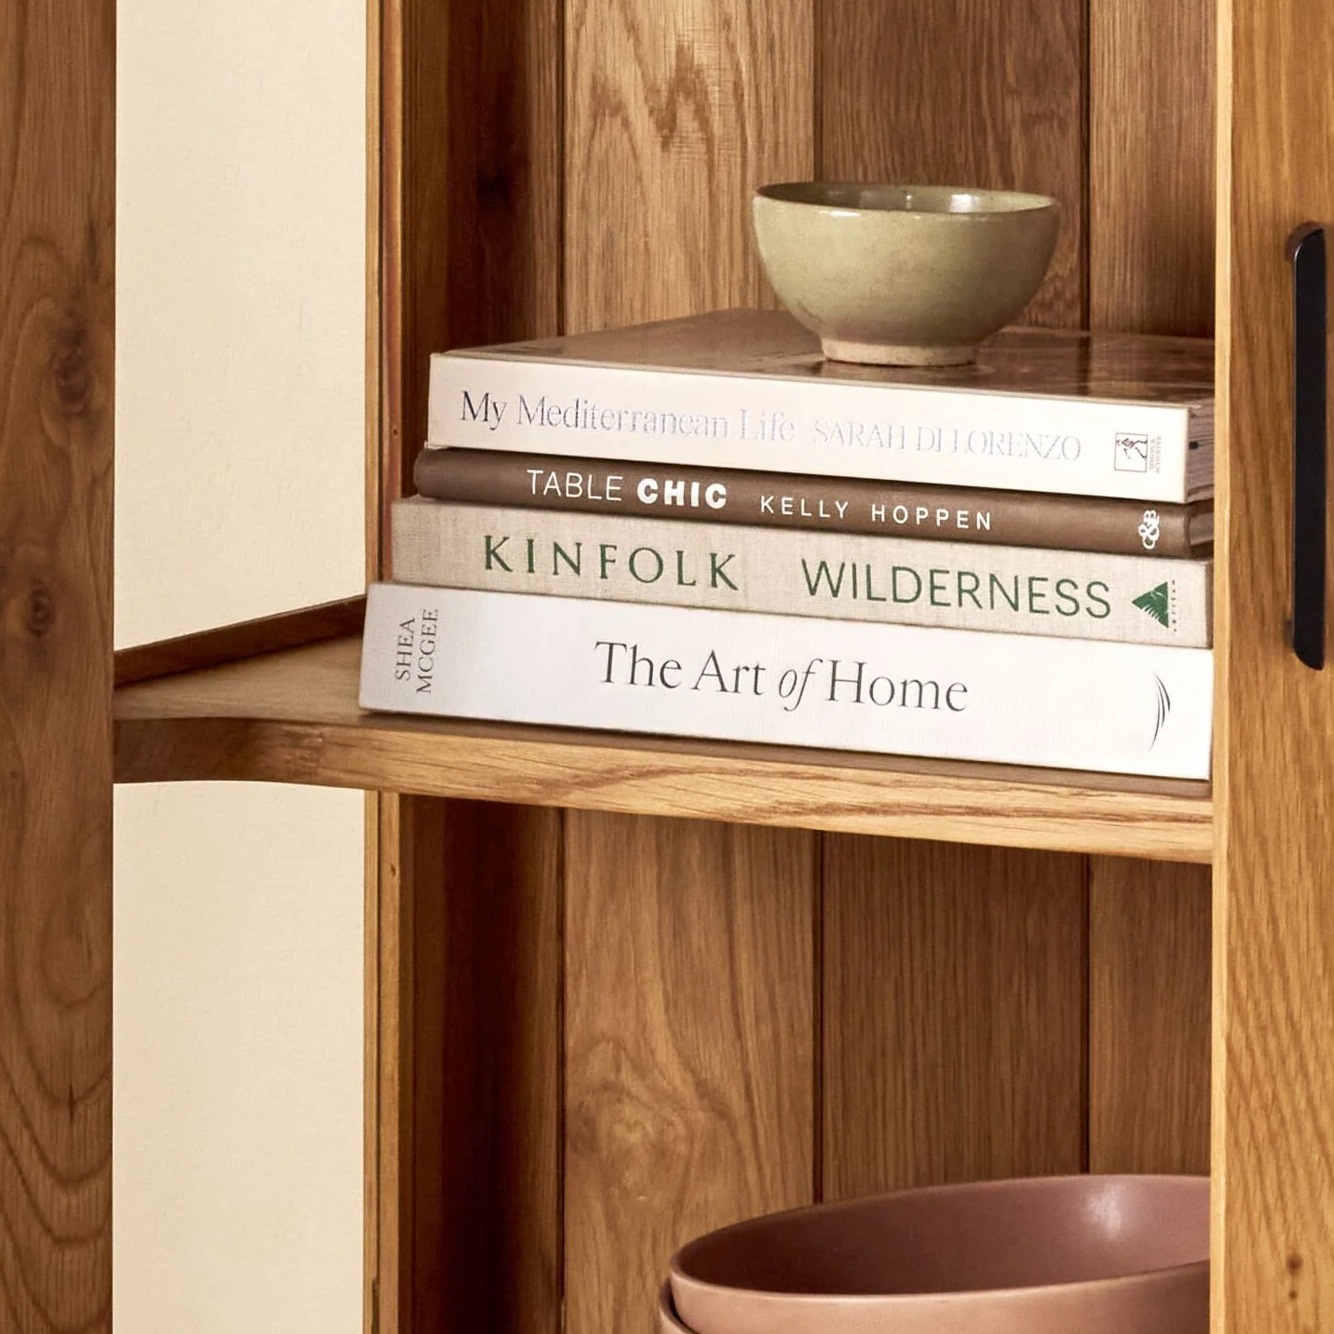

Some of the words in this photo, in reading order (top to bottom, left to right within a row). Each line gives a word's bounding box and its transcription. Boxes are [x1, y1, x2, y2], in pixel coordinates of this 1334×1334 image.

[460, 390, 507, 431] My
[516, 393, 728, 439] Mediterranean
[739, 408, 795, 442] Life
[813, 419, 905, 451] SARAH
[917, 427, 942, 452] DI
[952, 430, 1081, 462] LORENZO
[527, 470, 623, 501] TABLE
[637, 478, 727, 509] CHIC
[760, 495, 849, 520] KELLY
[871, 503, 992, 531] HOPPEN
[484, 535, 739, 591] KINFOLK
[801, 558, 1111, 619] WILDERNESS
[394, 617, 415, 681] SHEA
[416, 608, 438, 695] MCGEE
[596, 641, 682, 689] The
[692, 650, 766, 696] Art
[778, 657, 824, 712] of
[827, 660, 968, 712] Home
